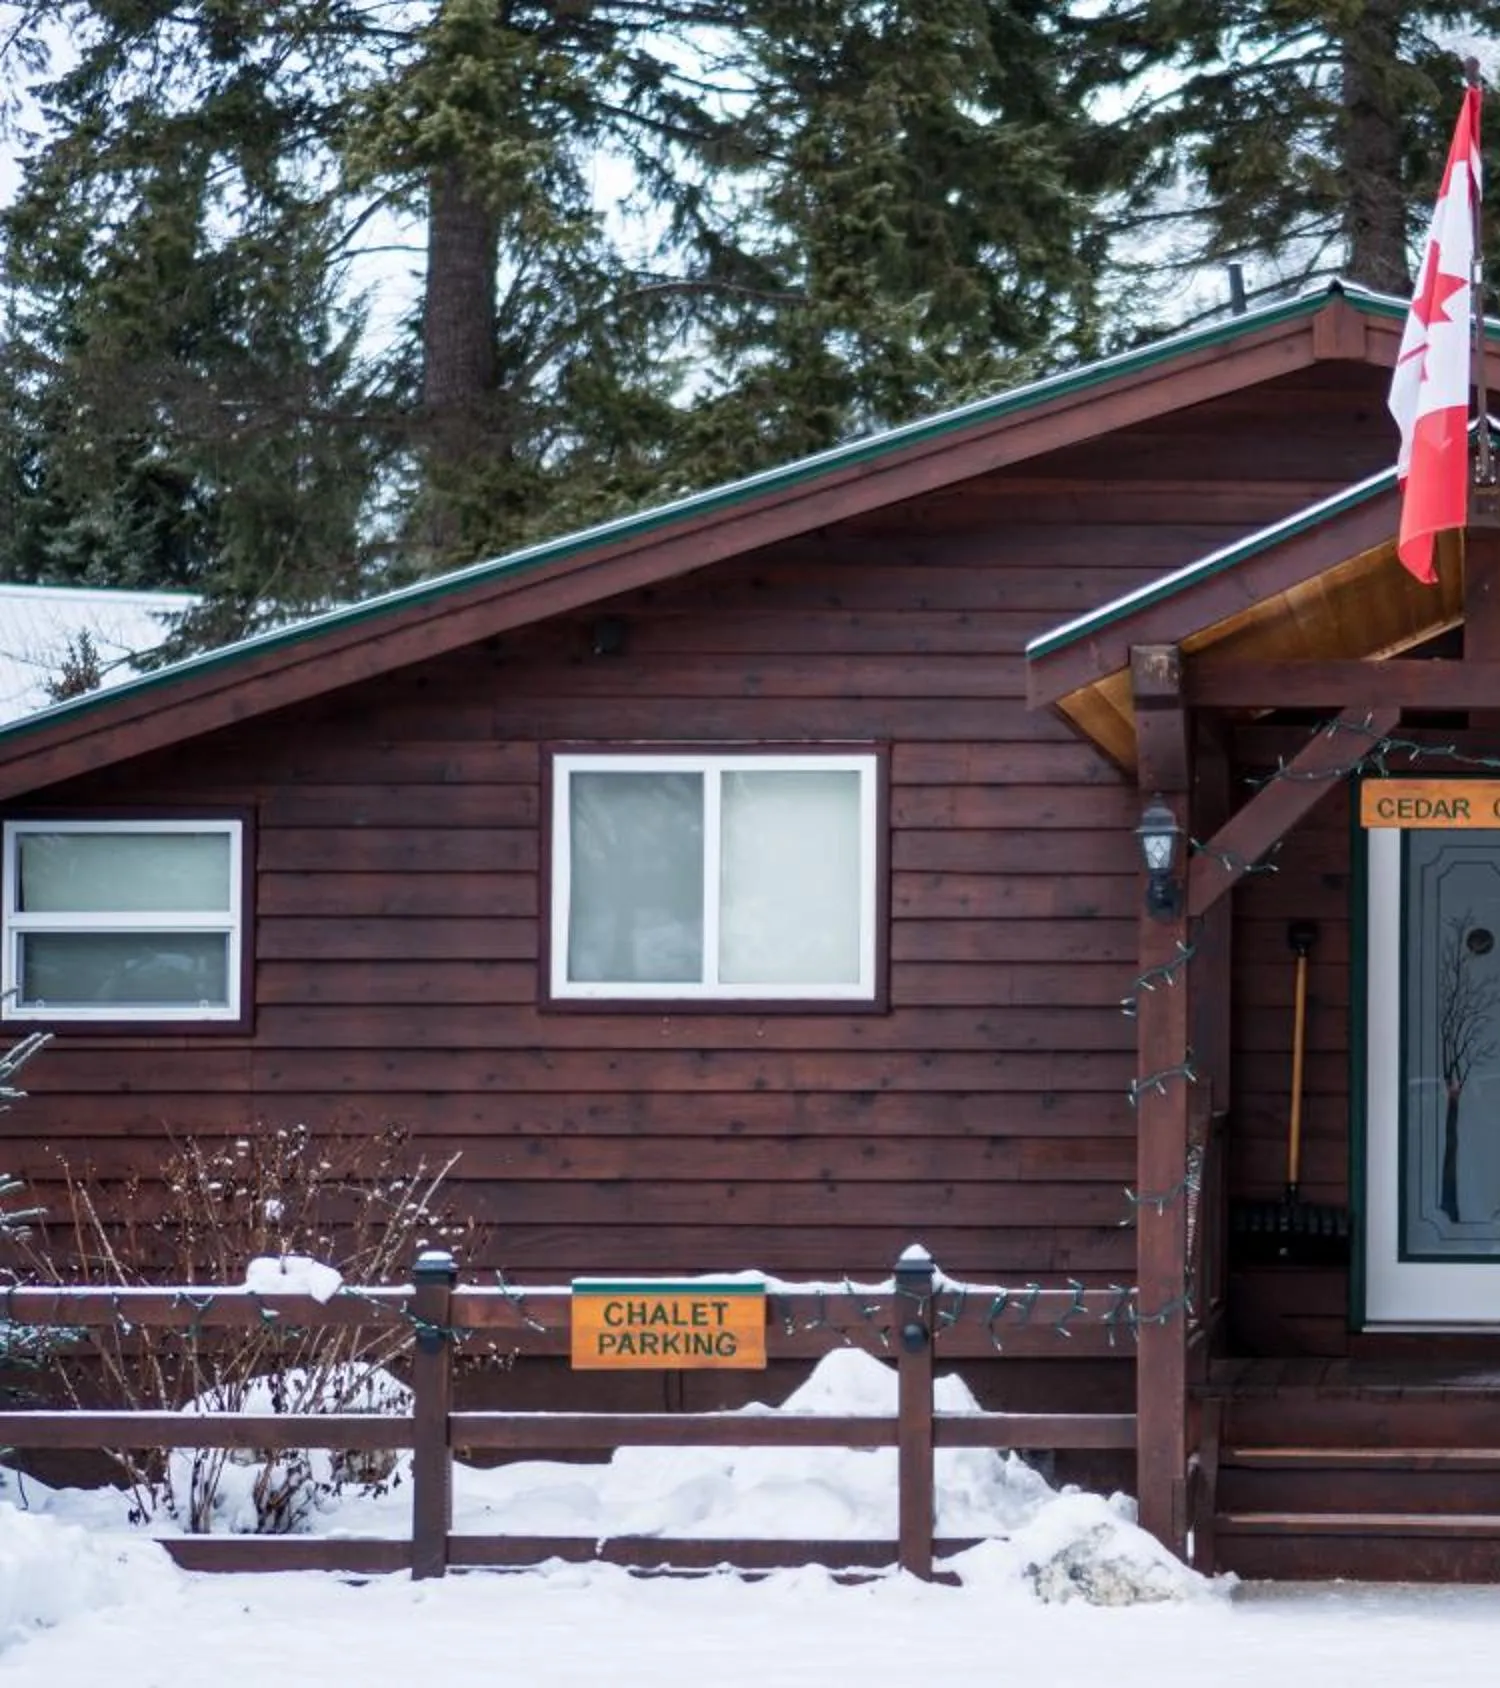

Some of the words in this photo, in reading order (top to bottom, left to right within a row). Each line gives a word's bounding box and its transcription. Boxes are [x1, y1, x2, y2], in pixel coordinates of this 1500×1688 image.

[1377, 798, 1470, 819] CEDAR
[604, 1302, 728, 1327] CHALET
[598, 1332, 737, 1357] PARKING
